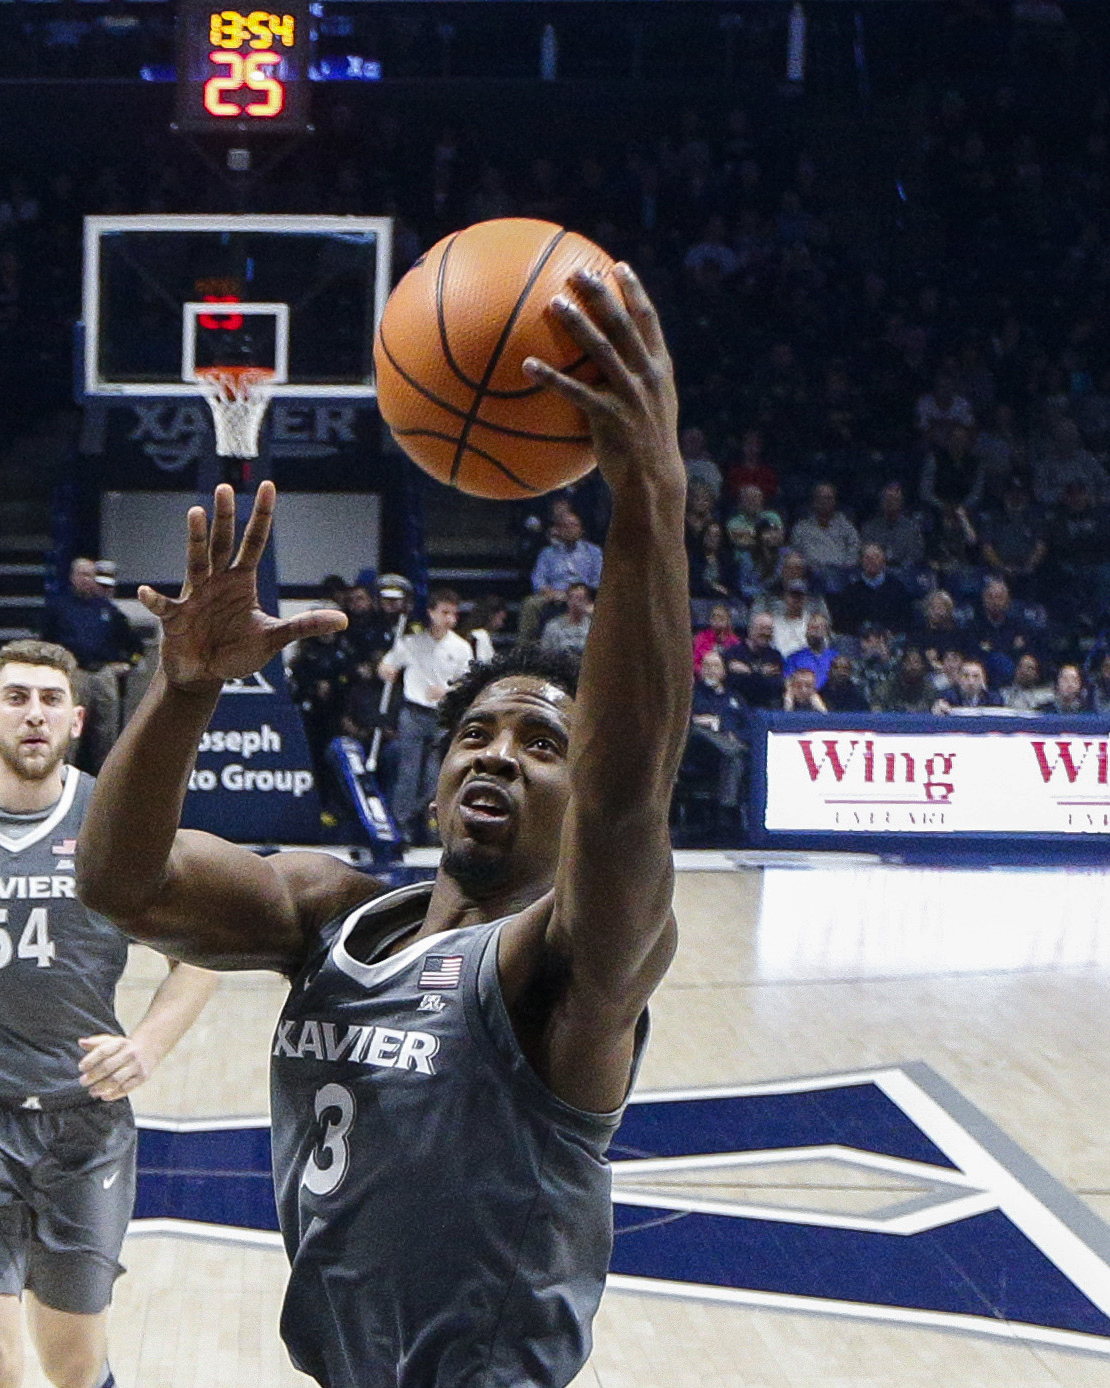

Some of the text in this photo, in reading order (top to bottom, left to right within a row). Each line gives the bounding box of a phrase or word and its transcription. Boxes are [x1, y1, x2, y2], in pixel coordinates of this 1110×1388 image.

[204, 50, 286, 117] 25
[130, 404, 357, 442] XAER
[221, 763, 314, 797] Group
[798, 740, 957, 801] Wing
[271, 1019, 440, 1075] XAVIER
[298, 1082, 355, 1196] 3
